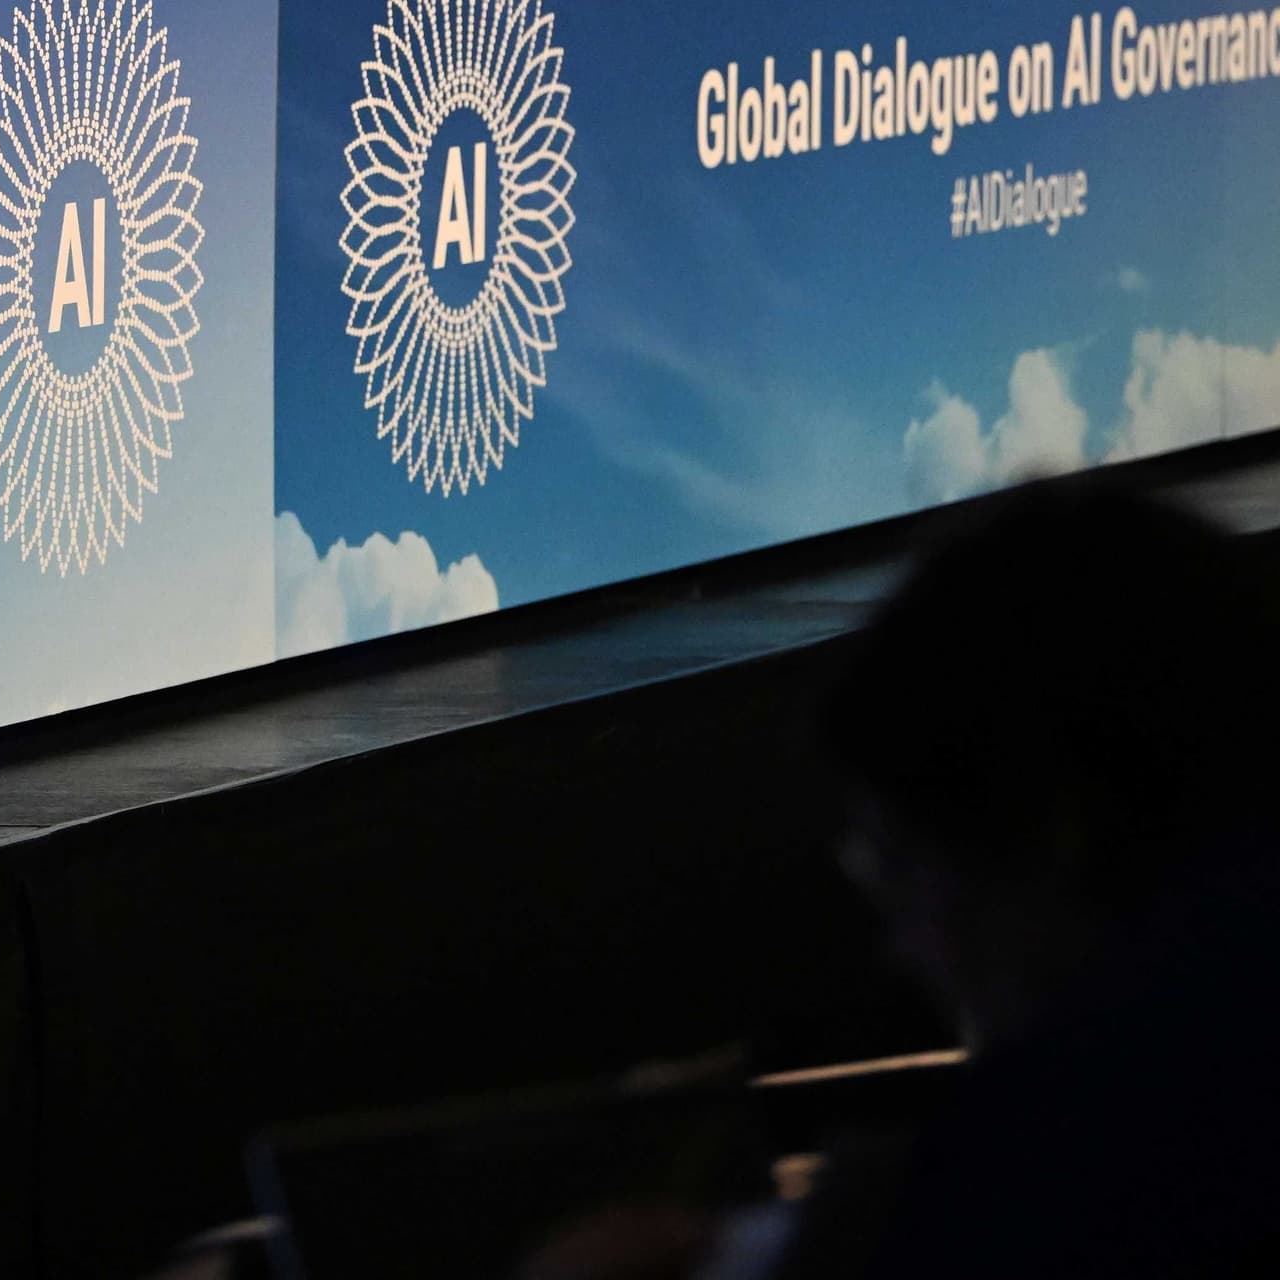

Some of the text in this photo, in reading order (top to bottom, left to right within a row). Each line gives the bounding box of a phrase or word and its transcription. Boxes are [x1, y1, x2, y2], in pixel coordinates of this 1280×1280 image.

[697, 49, 822, 169] Global
[834, 36, 999, 155] Dialogue
[1008, 42, 1053, 117] on
[1062, 12, 1101, 108] AI
[47, 197, 106, 334] AI
[433, 142, 487, 270] AI
[950, 164, 1087, 238] #AIDialogue
